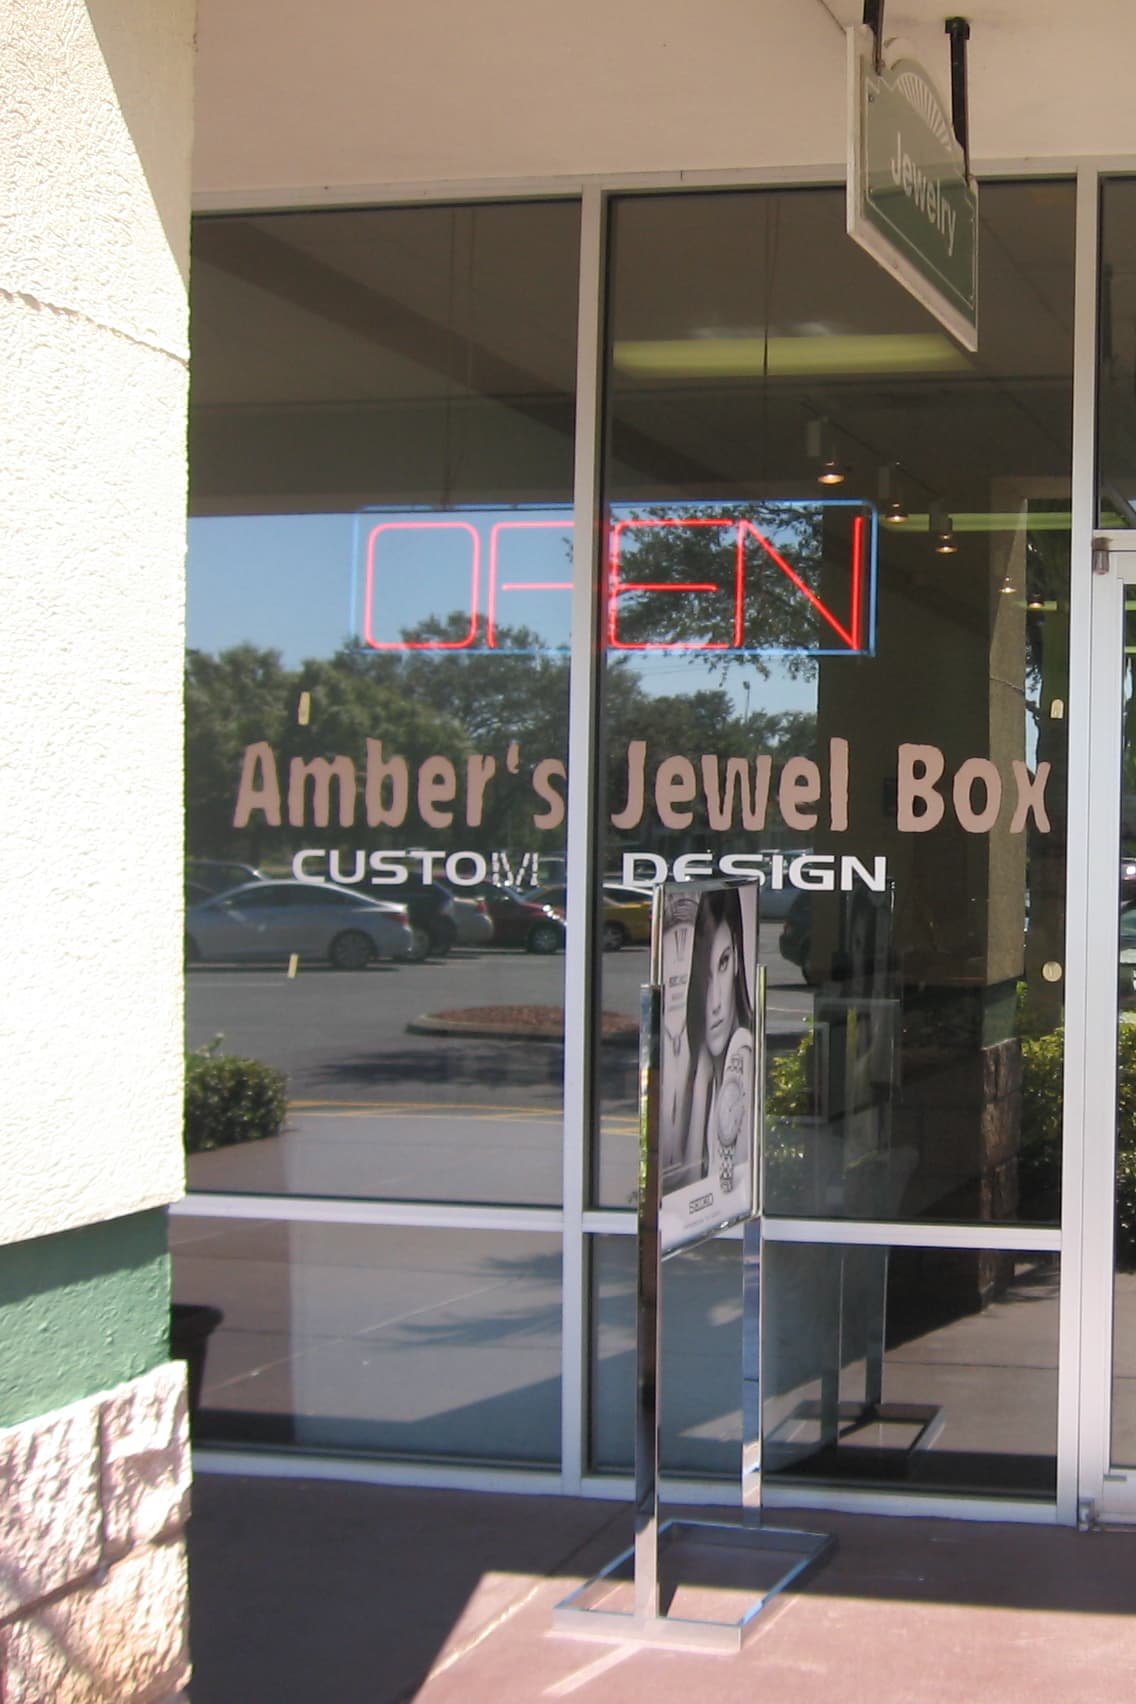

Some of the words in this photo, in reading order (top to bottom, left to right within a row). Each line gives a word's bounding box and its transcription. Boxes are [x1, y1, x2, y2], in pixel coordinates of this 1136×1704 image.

[891, 132, 956, 256] Jewelry
[233, 737, 567, 830] Amber's
[611, 737, 848, 831] Jewel
[897, 743, 1052, 833] Box
[292, 849, 541, 886] CUSTOM
[622, 852, 887, 891] DESIGN
